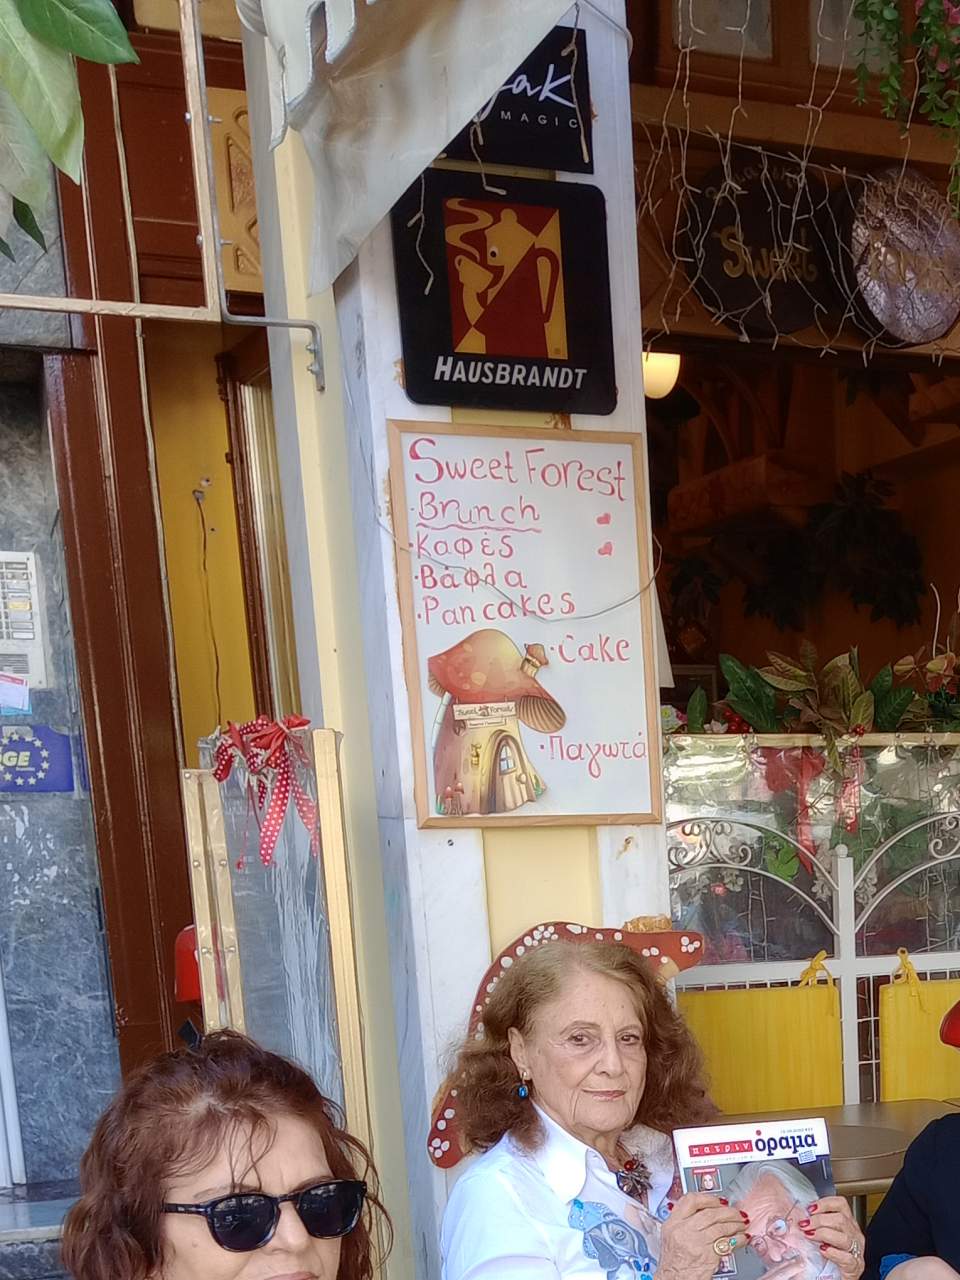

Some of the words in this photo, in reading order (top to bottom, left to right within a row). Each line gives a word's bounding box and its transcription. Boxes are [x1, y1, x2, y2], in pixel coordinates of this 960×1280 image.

[500, 110, 579, 129] MAGIC
[433, 355, 588, 390] HAUSBRANDT
[408, 437, 518, 484] Sweet
[525, 447, 627, 502] Forest
[418, 490, 540, 524] Brunch
[422, 592, 576, 626] Pancakes
[558, 633, 631, 664] Cake
[549, 731, 647, 779] Παγωτά
